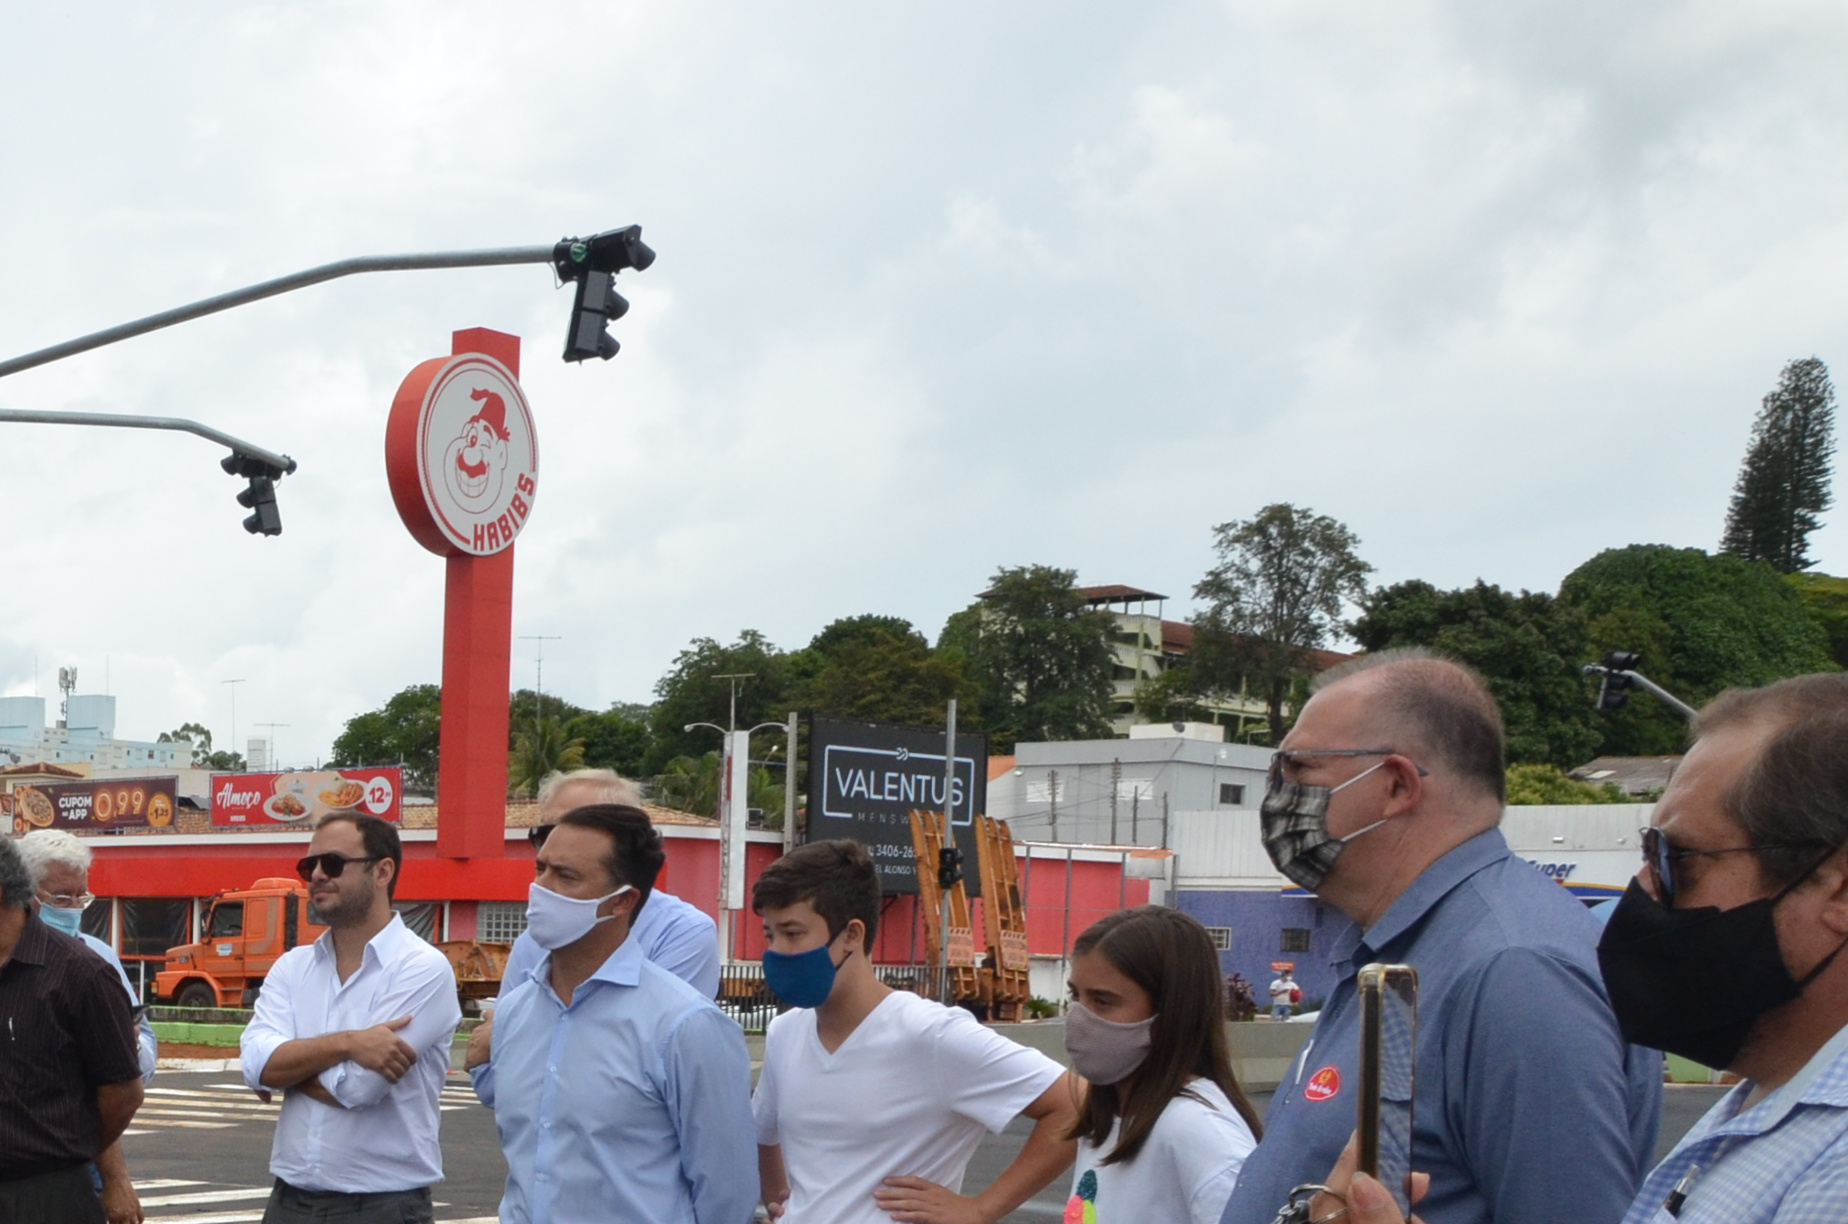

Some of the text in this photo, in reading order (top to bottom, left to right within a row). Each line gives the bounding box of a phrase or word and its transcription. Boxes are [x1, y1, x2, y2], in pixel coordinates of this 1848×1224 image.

[473, 472, 534, 552] HABIB'S
[835, 767, 963, 806] VALENTUS
[59, 796, 92, 809] CUPOM
[216, 782, 261, 810] Almoço
[68, 808, 88, 820] APP
[857, 811, 911, 825] MENSW
[875, 843, 917, 859] 3406-26
[884, 865, 911, 875] ALONSO
